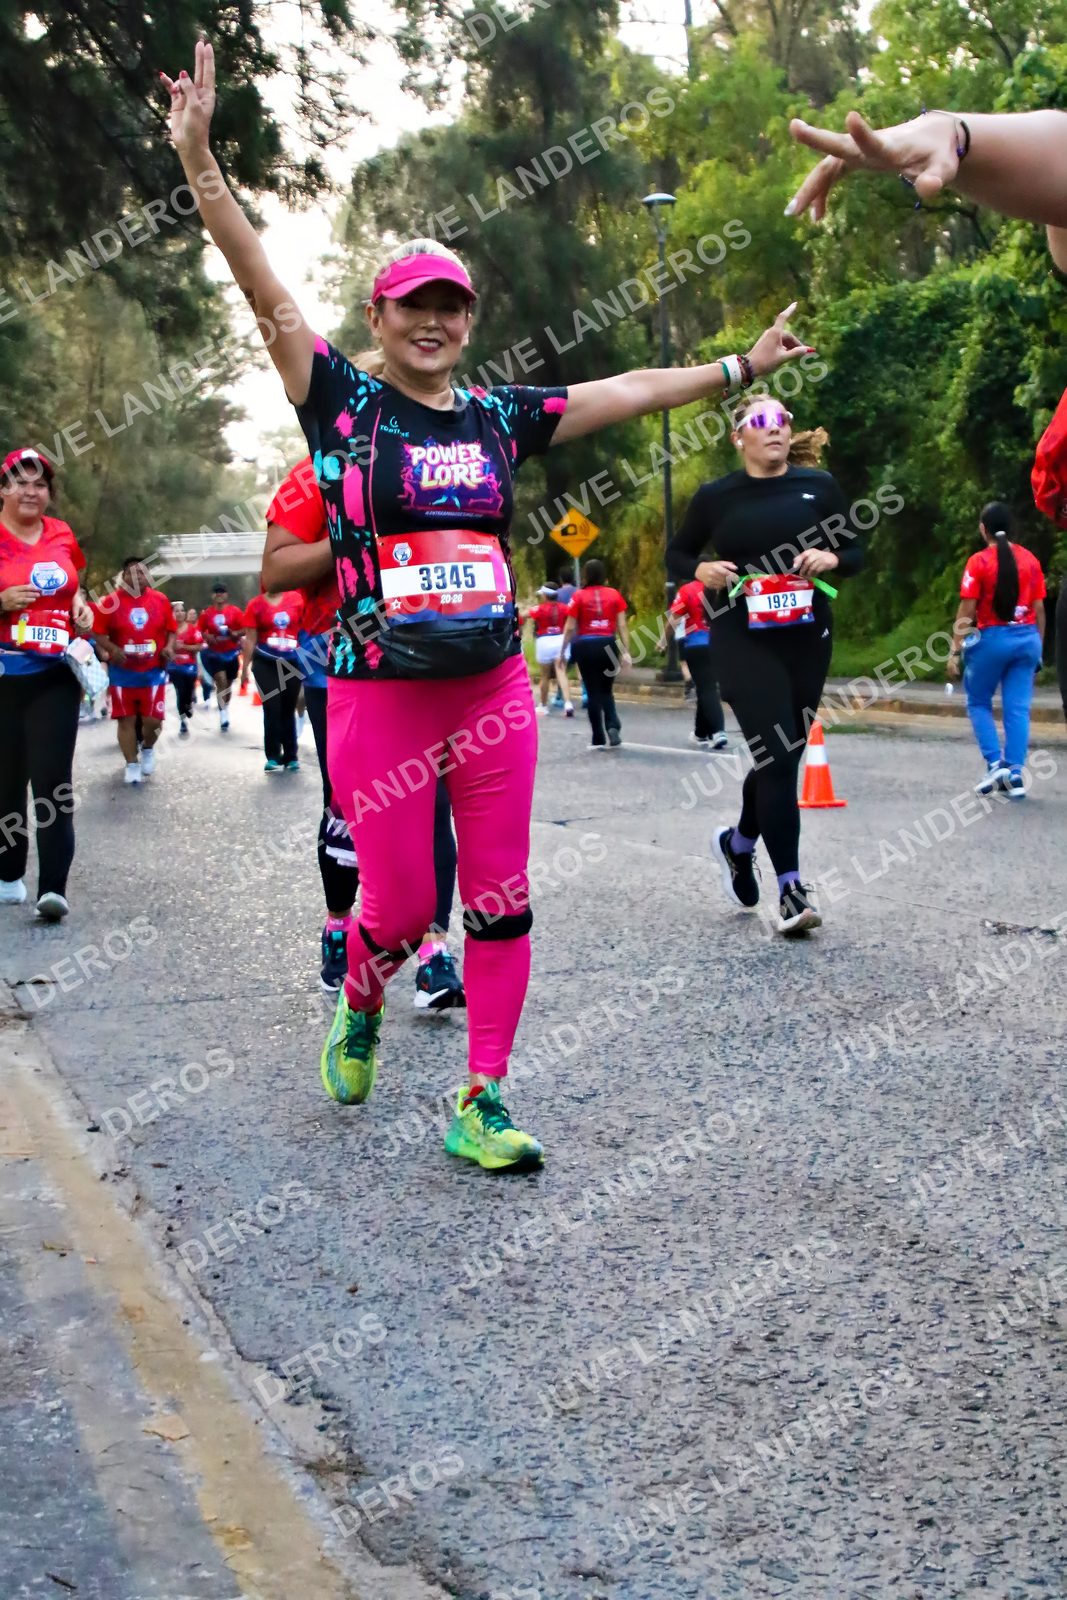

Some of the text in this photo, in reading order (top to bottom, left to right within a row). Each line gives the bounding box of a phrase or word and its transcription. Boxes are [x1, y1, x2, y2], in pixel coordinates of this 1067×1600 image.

[409, 442, 489, 466] POWER
[421, 462, 485, 490] LORE
[418, 563, 476, 591] 3345
[491, 604, 505, 613] 5K
[767, 593, 797, 609] 1923
[32, 627, 57, 642] 1829
